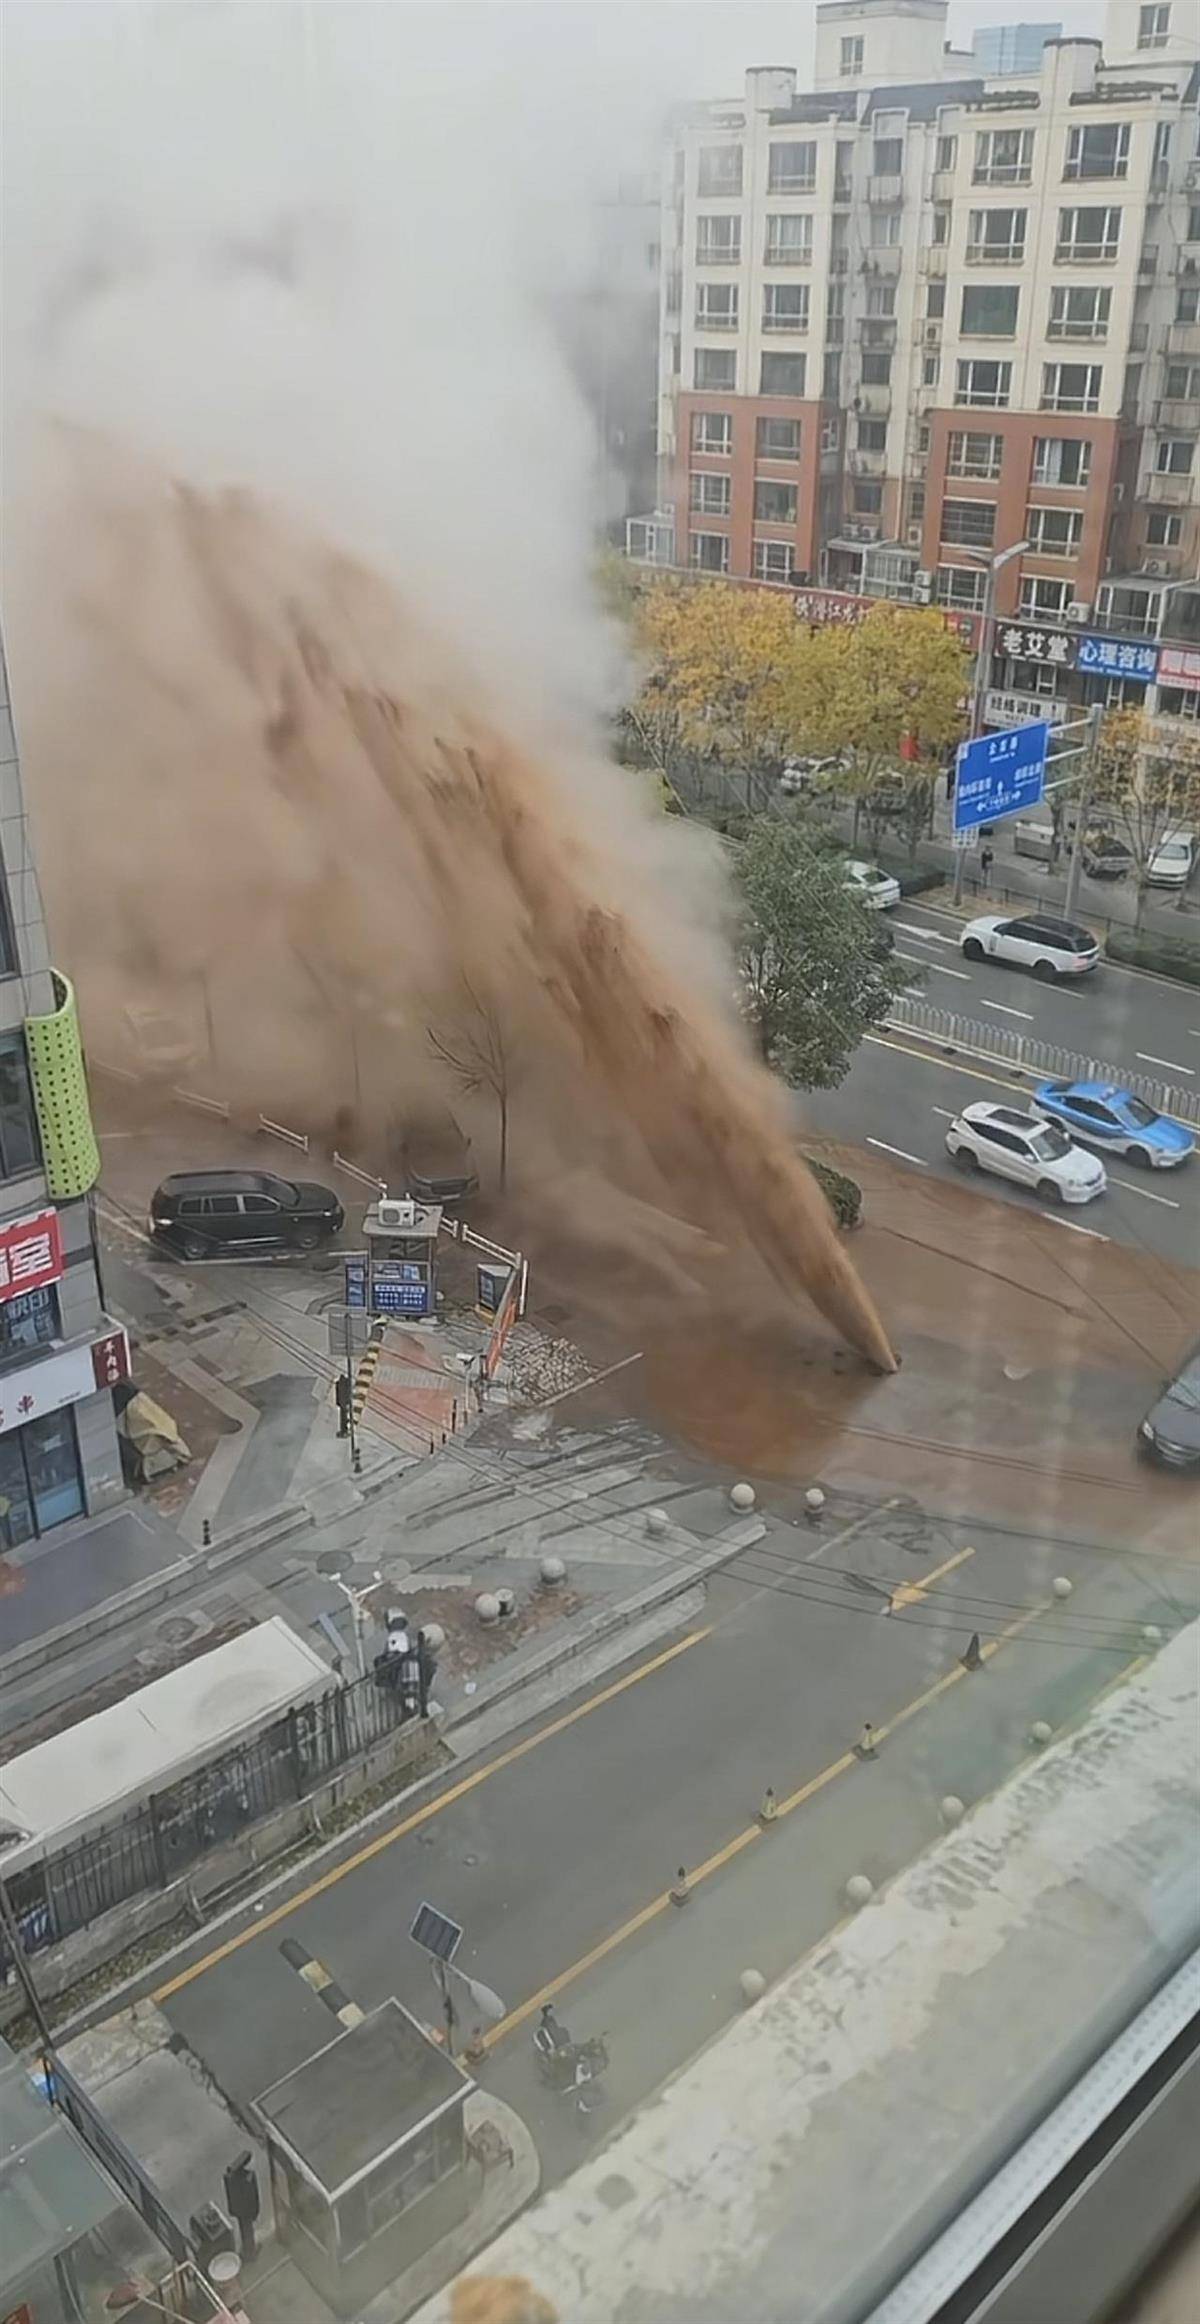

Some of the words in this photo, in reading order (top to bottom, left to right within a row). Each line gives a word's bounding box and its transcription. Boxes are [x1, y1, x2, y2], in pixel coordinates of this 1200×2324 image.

[1003, 628, 1069, 662] 老艾堂
[1078, 639, 1157, 673] 心理咨询
